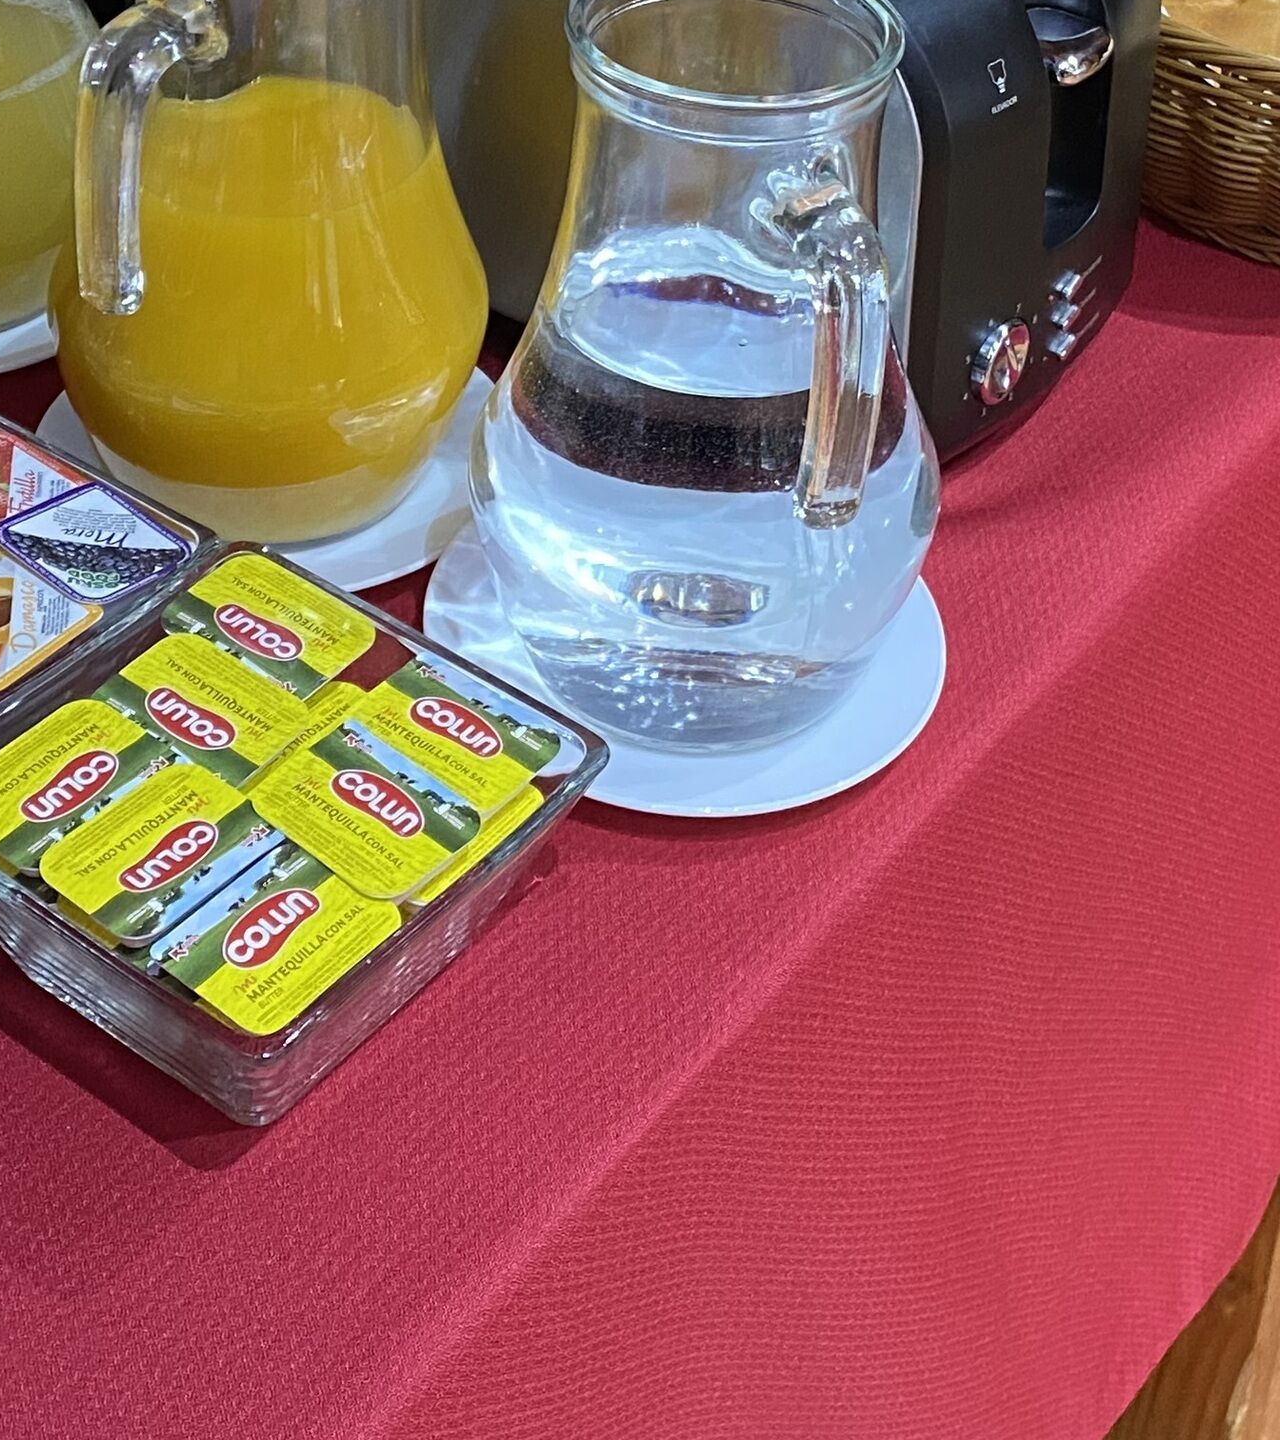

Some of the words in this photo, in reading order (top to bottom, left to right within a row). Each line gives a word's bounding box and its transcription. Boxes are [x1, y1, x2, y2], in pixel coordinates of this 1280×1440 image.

[8, 469, 36, 514] Frutilla
[60, 528, 128, 548] Mora
[68, 570, 119, 580] FOOD
[232, 577, 247, 594] SAL
[246, 587, 266, 603] CON
[10, 581, 37, 653] Damasco
[219, 606, 297, 659] COLUN
[265, 597, 340, 645] MANTEQUILLA
[167, 659, 182, 673] SAL
[181, 671, 200, 686] CON
[150, 691, 229, 747] COLUN
[198, 681, 274, 732] MANTEQUILLA
[416, 700, 497, 756] COLUN
[18, 723, 100, 782] MANTEQUILLA
[373, 713, 451, 763] MANTEQUILLA
[448, 758, 471, 775] CON
[469, 771, 490, 788] SAL
[26, 754, 115, 818] COLUN
[338, 772, 419, 836] COLUN
[114, 790, 199, 852] MANTEQUILLA
[291, 784, 368, 841] MANTEQUILLA
[365, 832, 386, 853] CON
[384, 851, 404, 870] SAL
[74, 862, 96, 878] SAL
[94, 849, 117, 866] CON
[125, 825, 214, 888] COLUN
[227, 891, 314, 963] COLUN
[247, 935, 329, 1004] MANTEQUILLA
[324, 919, 347, 939] CON
[344, 904, 365, 923] SAL
